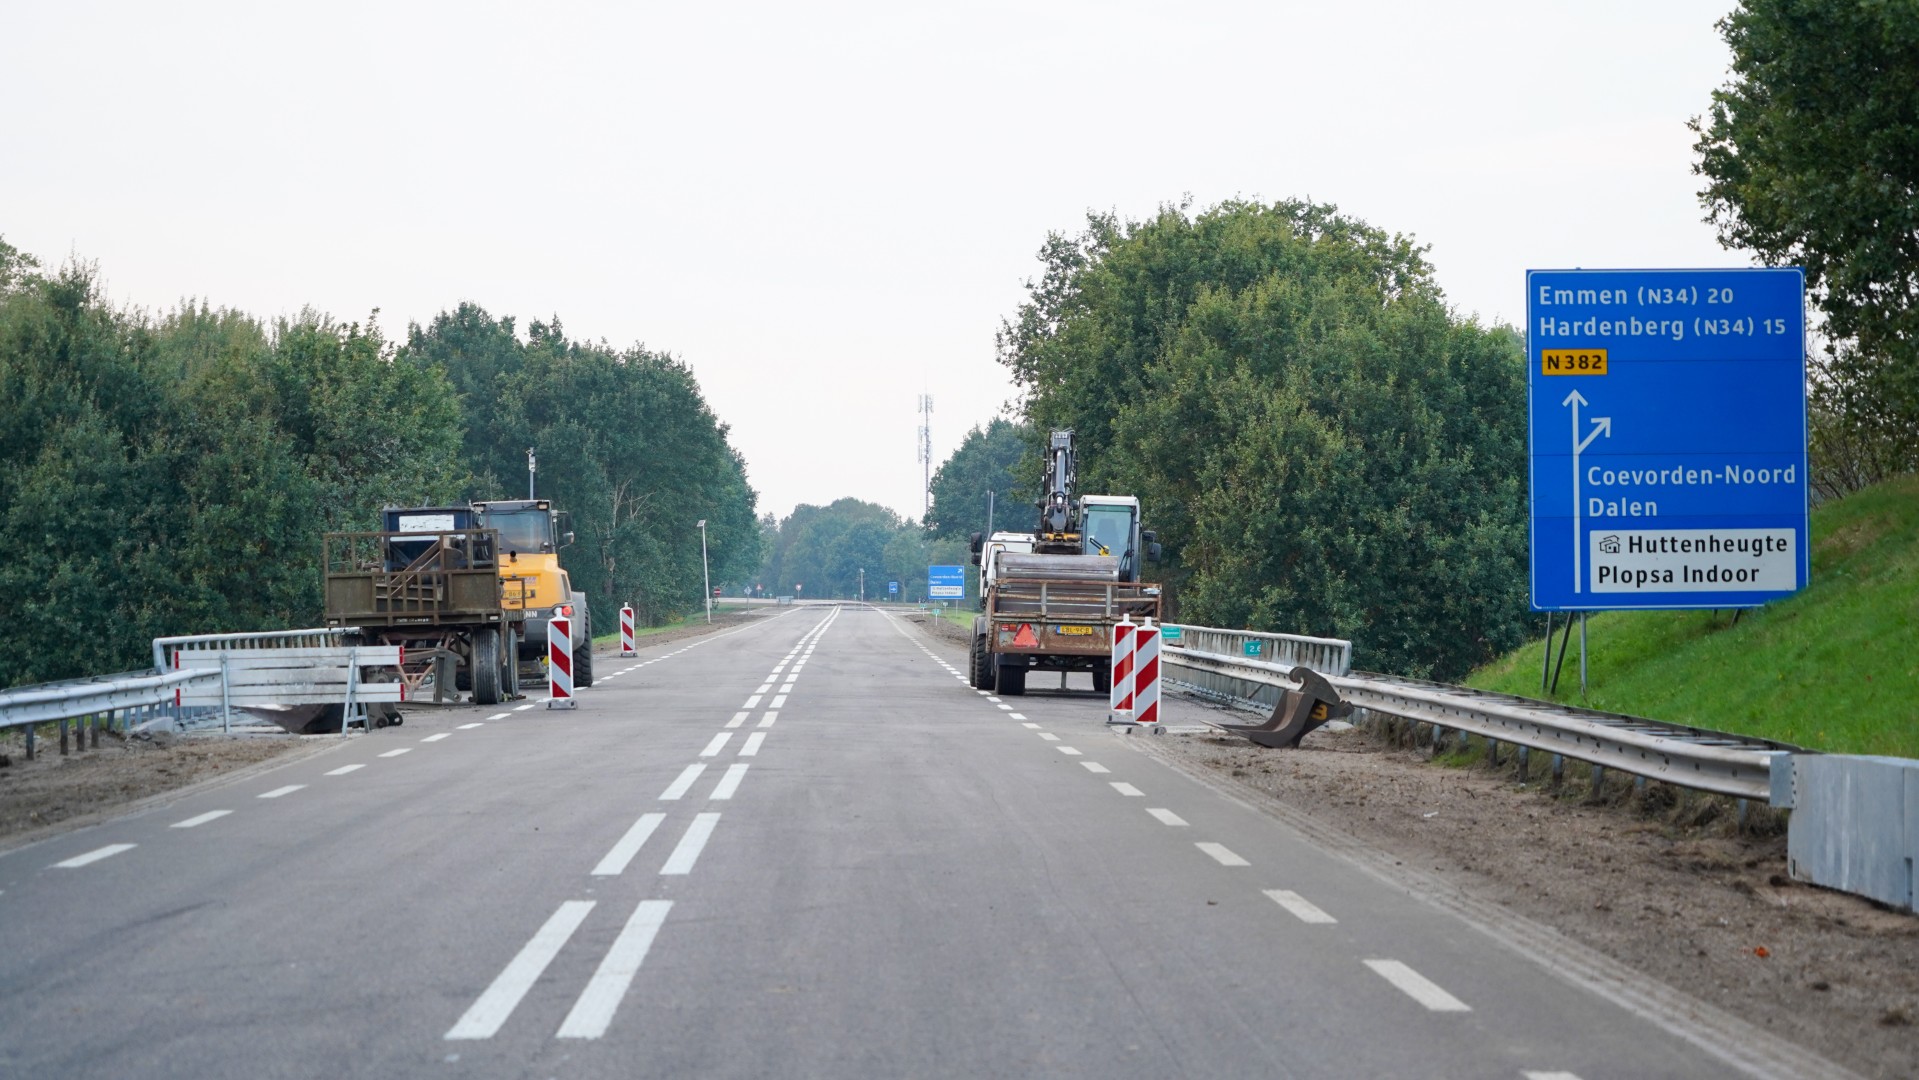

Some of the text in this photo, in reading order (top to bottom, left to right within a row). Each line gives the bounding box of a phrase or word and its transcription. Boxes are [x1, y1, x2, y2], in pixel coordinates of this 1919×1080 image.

[1539, 286, 1734, 306] Emmen (N34) 20
[1540, 316, 1786, 340] Hardenberg (N34) 15
[1546, 354, 1603, 370] N382
[1587, 464, 1796, 486] Coevorden-Noord
[1589, 497, 1658, 517] Dalen
[1628, 534, 1788, 557] Huttenheugte
[1598, 564, 1760, 588] Plopsa Indoor
